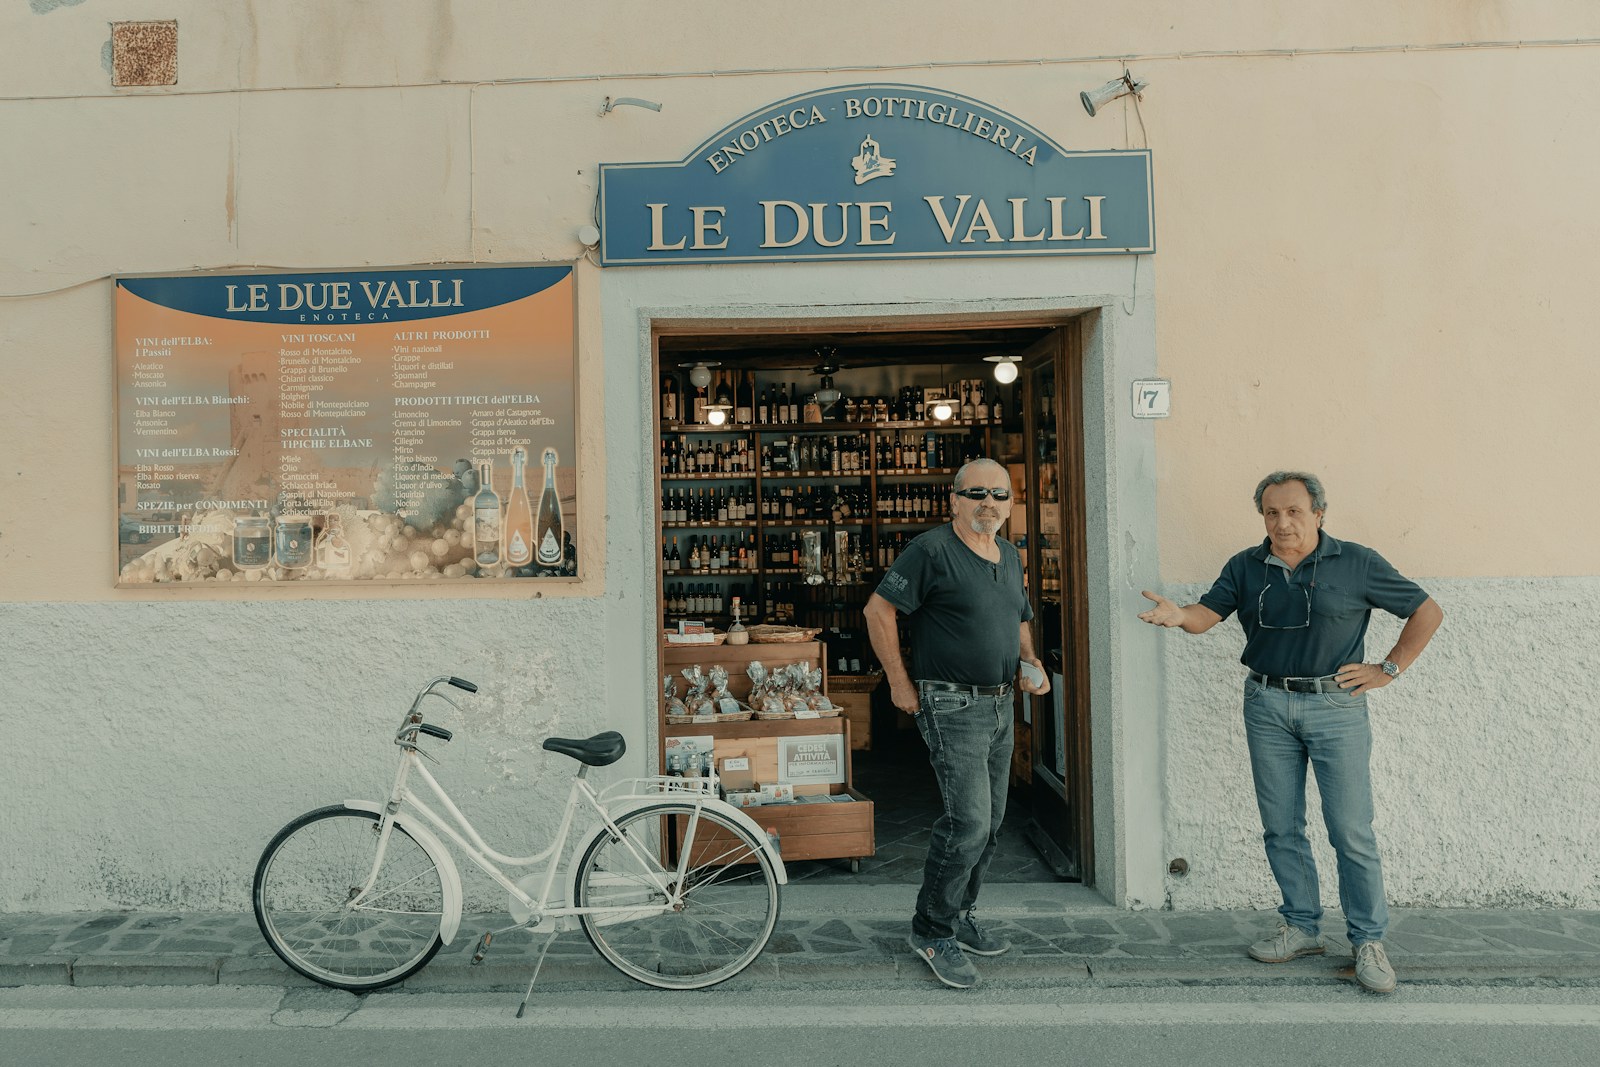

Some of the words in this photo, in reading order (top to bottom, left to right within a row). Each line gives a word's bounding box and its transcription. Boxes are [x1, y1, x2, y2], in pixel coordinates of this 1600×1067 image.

[706, 106, 828, 175] ENOTECA
[844, 98, 1041, 167] BOTTIGLIERIA
[646, 203, 729, 252] LE
[759, 200, 897, 249] DUE
[924, 194, 1107, 244] VALLI
[226, 284, 270, 312] LE
[279, 282, 352, 310] DUE
[360, 279, 464, 308] VALLI
[300, 313, 390, 322] ENOTECA
[282, 334, 304, 342] VINI
[307, 333, 355, 342] TOSCANI
[394, 332, 428, 340] ALTRI
[433, 330, 490, 340] PRODOTTI
[136, 338, 158, 346] VINI
[162, 337, 213, 345] dell'ELBA:
[142, 348, 172, 356] Passiti
[281, 366, 306, 374] Grappa
[394, 372, 427, 380] Spumanti
[394, 381, 436, 389] Champagne
[136, 397, 158, 406] VINI
[162, 396, 210, 405] dell'ELBA
[212, 396, 250, 404] Bianchi:
[281, 393, 310, 401] Bolgheri
[395, 397, 451, 406] PRODOTTI
[454, 396, 488, 405] TIPICI
[492, 395, 540, 404] dell'ELBA
[1144, 390, 1158, 408] 7
[316, 401, 369, 409] Montepulciano
[313, 410, 366, 418] Montepulciano
[507, 409, 541, 417] Castagnone
[472, 419, 494, 427] Grappa
[281, 426, 346, 437] SPECIALITÀ
[472, 428, 494, 437] Grappa
[281, 440, 326, 448] TIPICHE
[330, 439, 372, 448] ELBANE
[472, 438, 494, 446] Grappa
[136, 448, 159, 458] VINI
[162, 448, 210, 457] dell'ELBA
[212, 448, 240, 456] Rossi:
[473, 447, 494, 456] Grappa
[396, 473, 420, 481] Liquore
[138, 502, 175, 511] SPEZIE
[176, 503, 193, 512] per
[195, 500, 268, 510] CONDIMENTI
[139, 525, 175, 534] BIBITE
[794, 750, 830, 761] ATTIVITÀ
